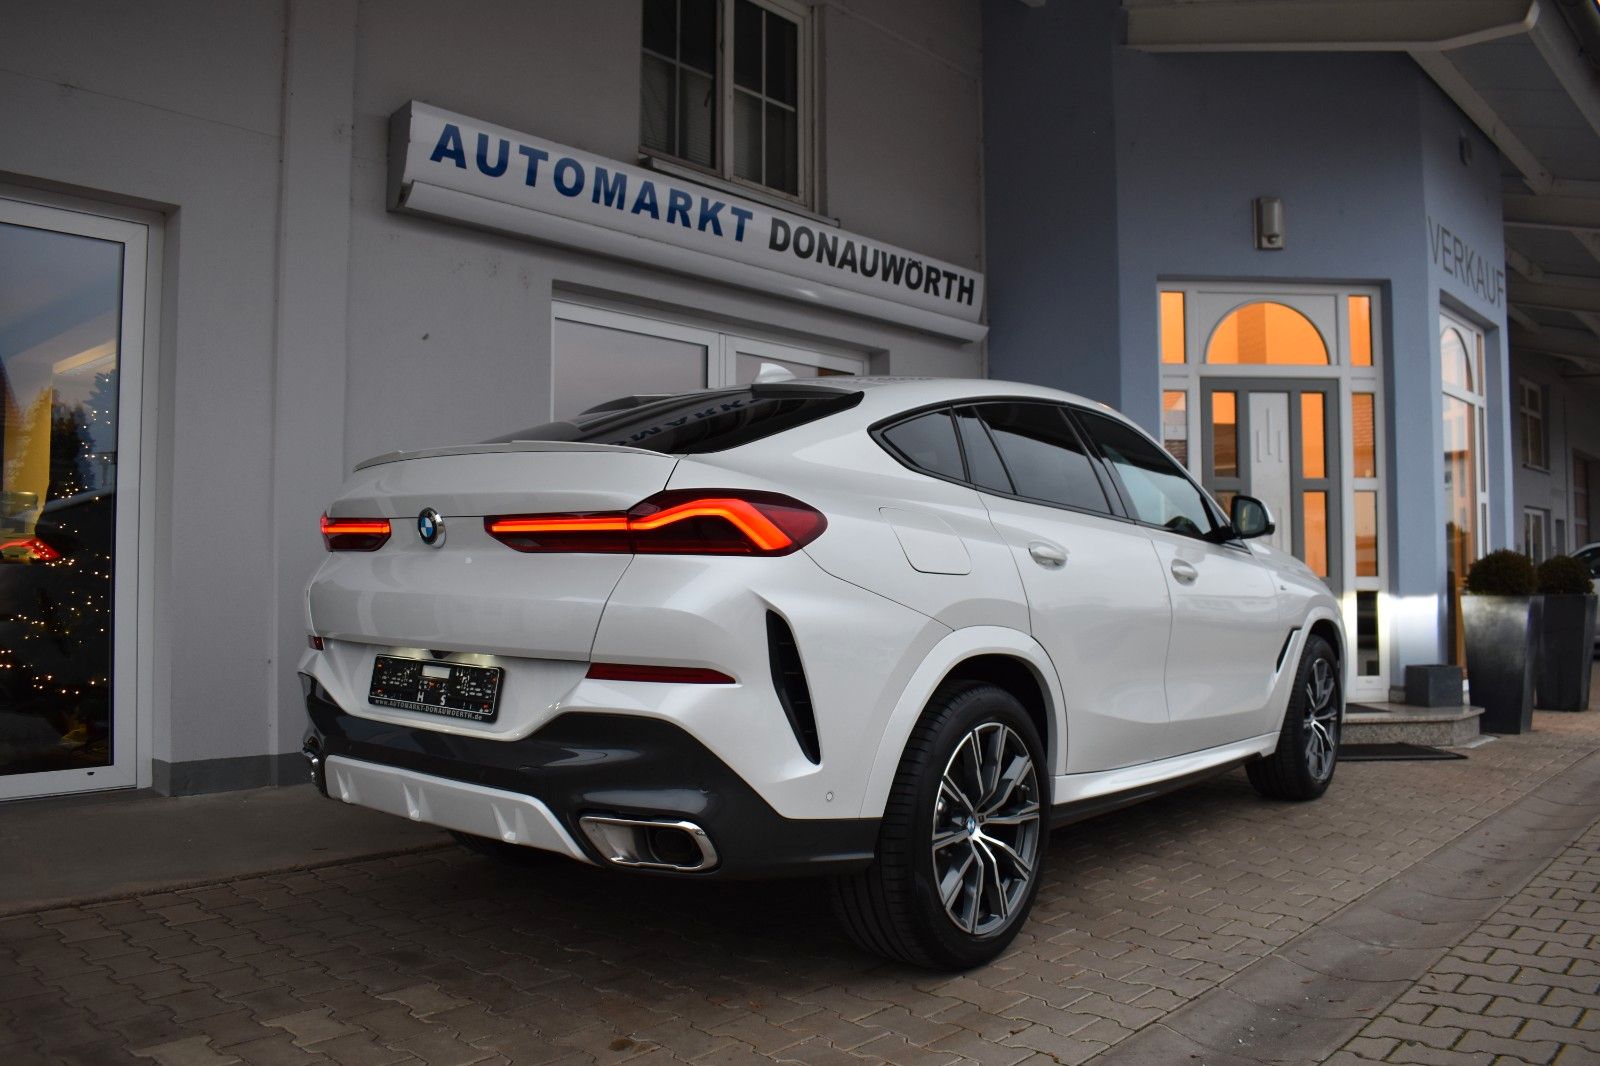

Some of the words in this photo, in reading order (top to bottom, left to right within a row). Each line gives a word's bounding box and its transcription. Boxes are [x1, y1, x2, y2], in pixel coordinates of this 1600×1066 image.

[430, 123, 753, 242] AUTOMARKT
[769, 216, 975, 306] DONAUWÖRTH
[1428, 216, 1504, 308] VERKAUF
